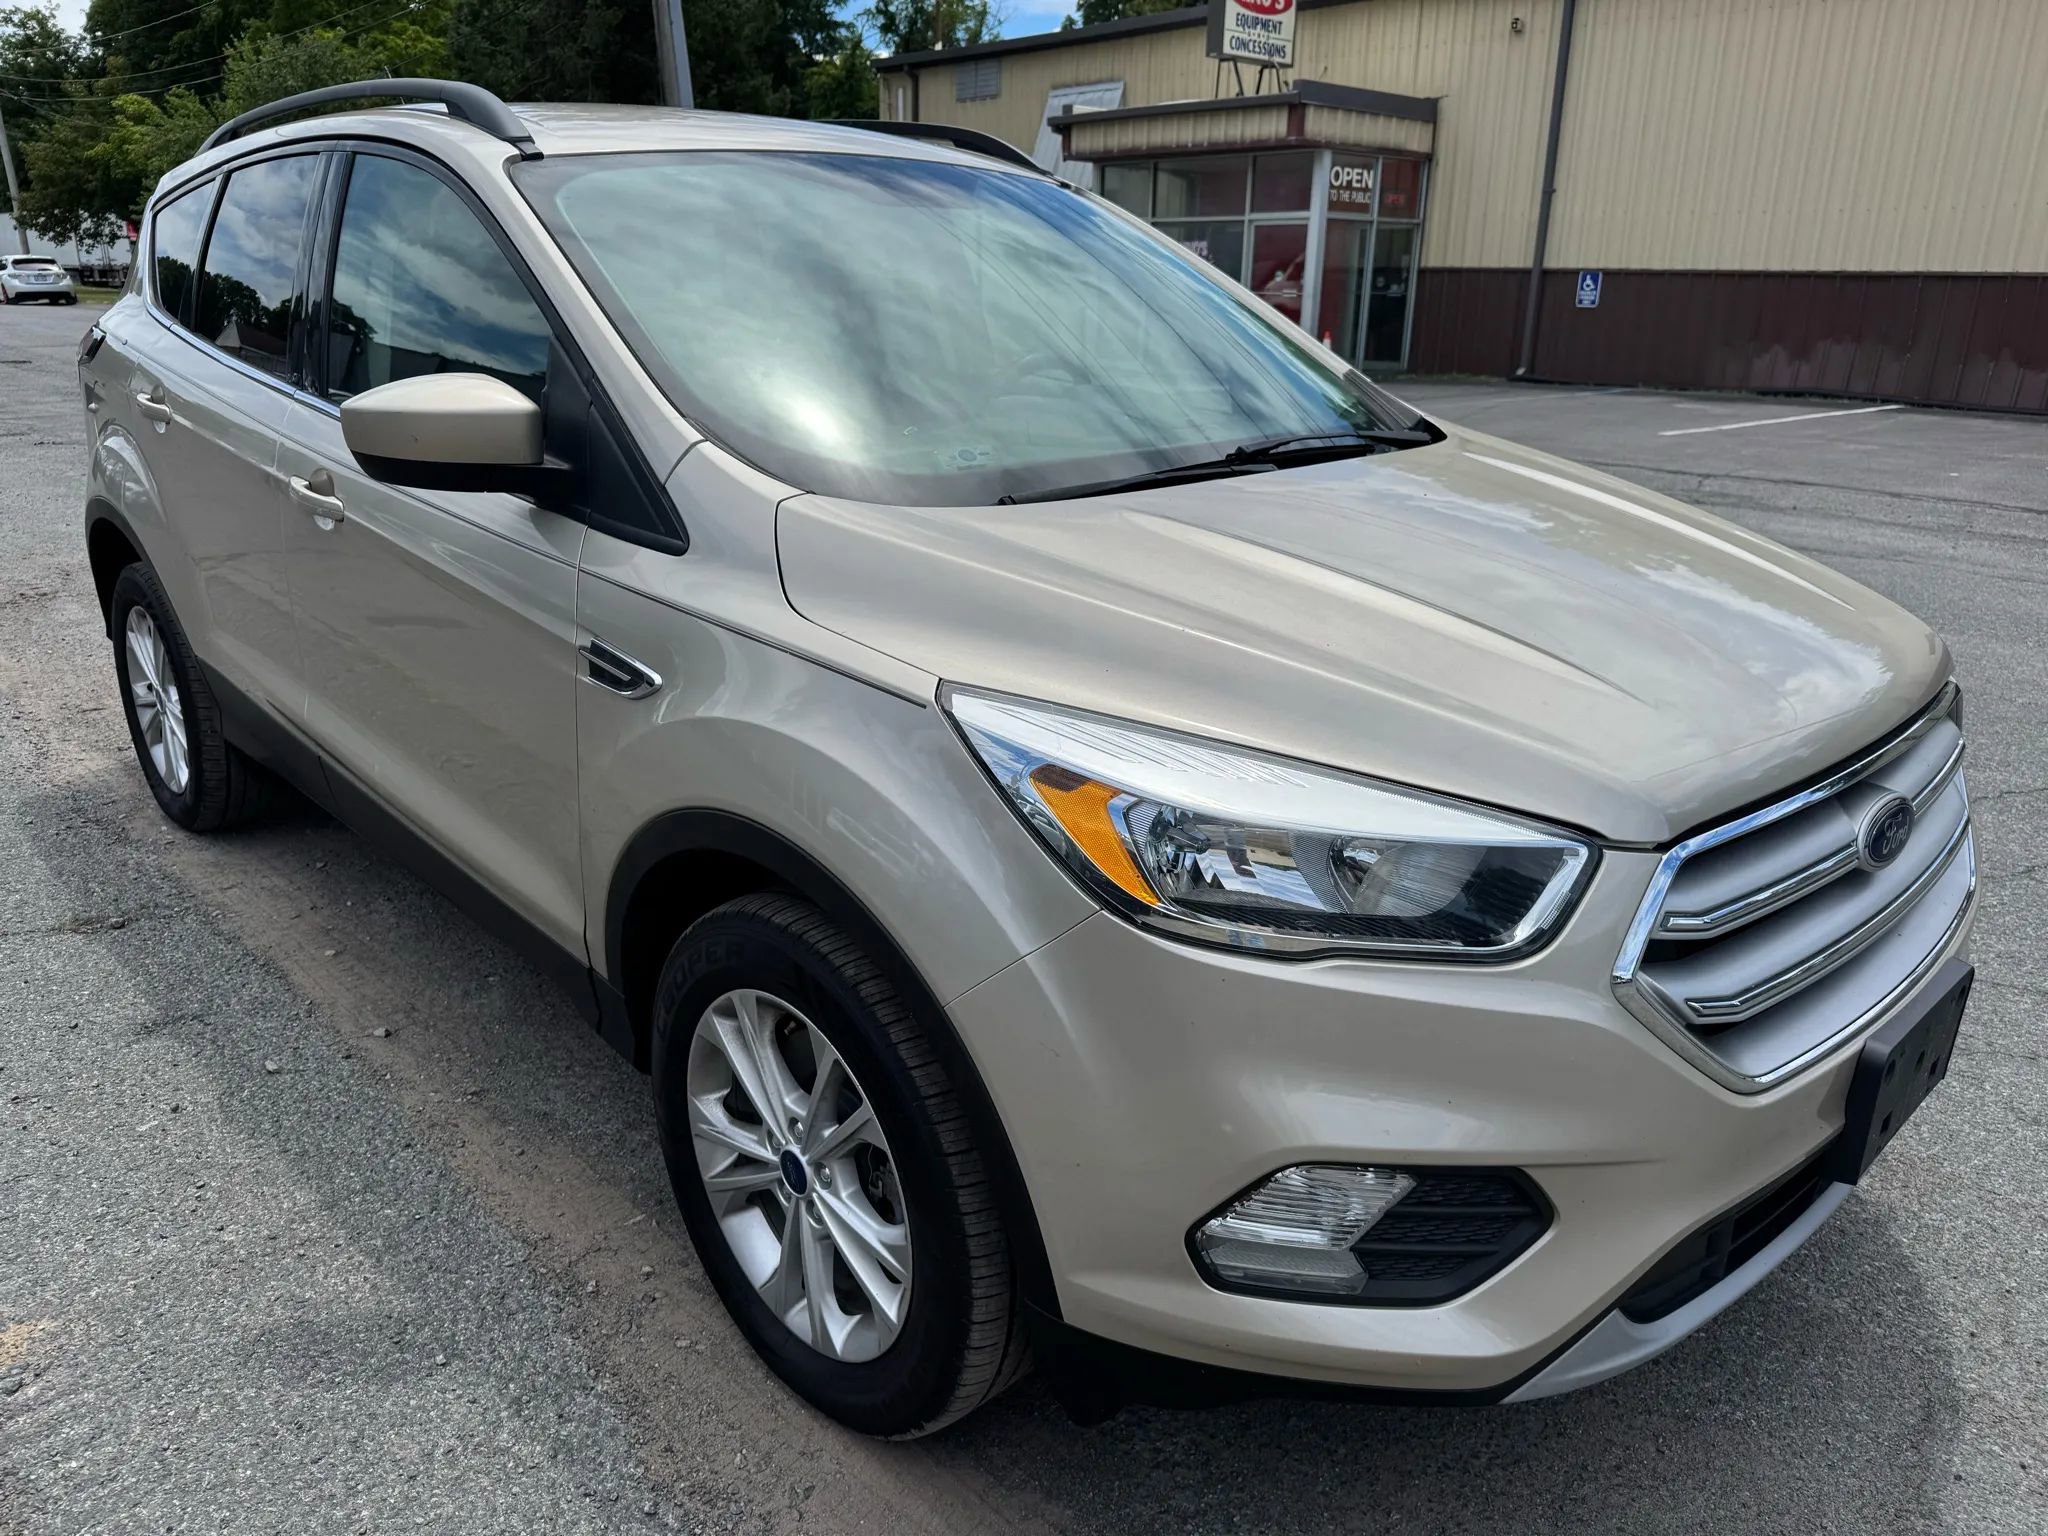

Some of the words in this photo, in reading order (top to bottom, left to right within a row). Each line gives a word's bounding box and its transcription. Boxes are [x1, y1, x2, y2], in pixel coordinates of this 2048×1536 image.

[1235, 12, 1283, 35] EQUIPMENT
[1229, 35, 1286, 59] CONCESSIONS
[1330, 166, 1373, 189] OPEN
[1330, 189, 1338, 201] TO
[1339, 190, 1350, 202] THE
[1351, 190, 1371, 203] PUBLIC
